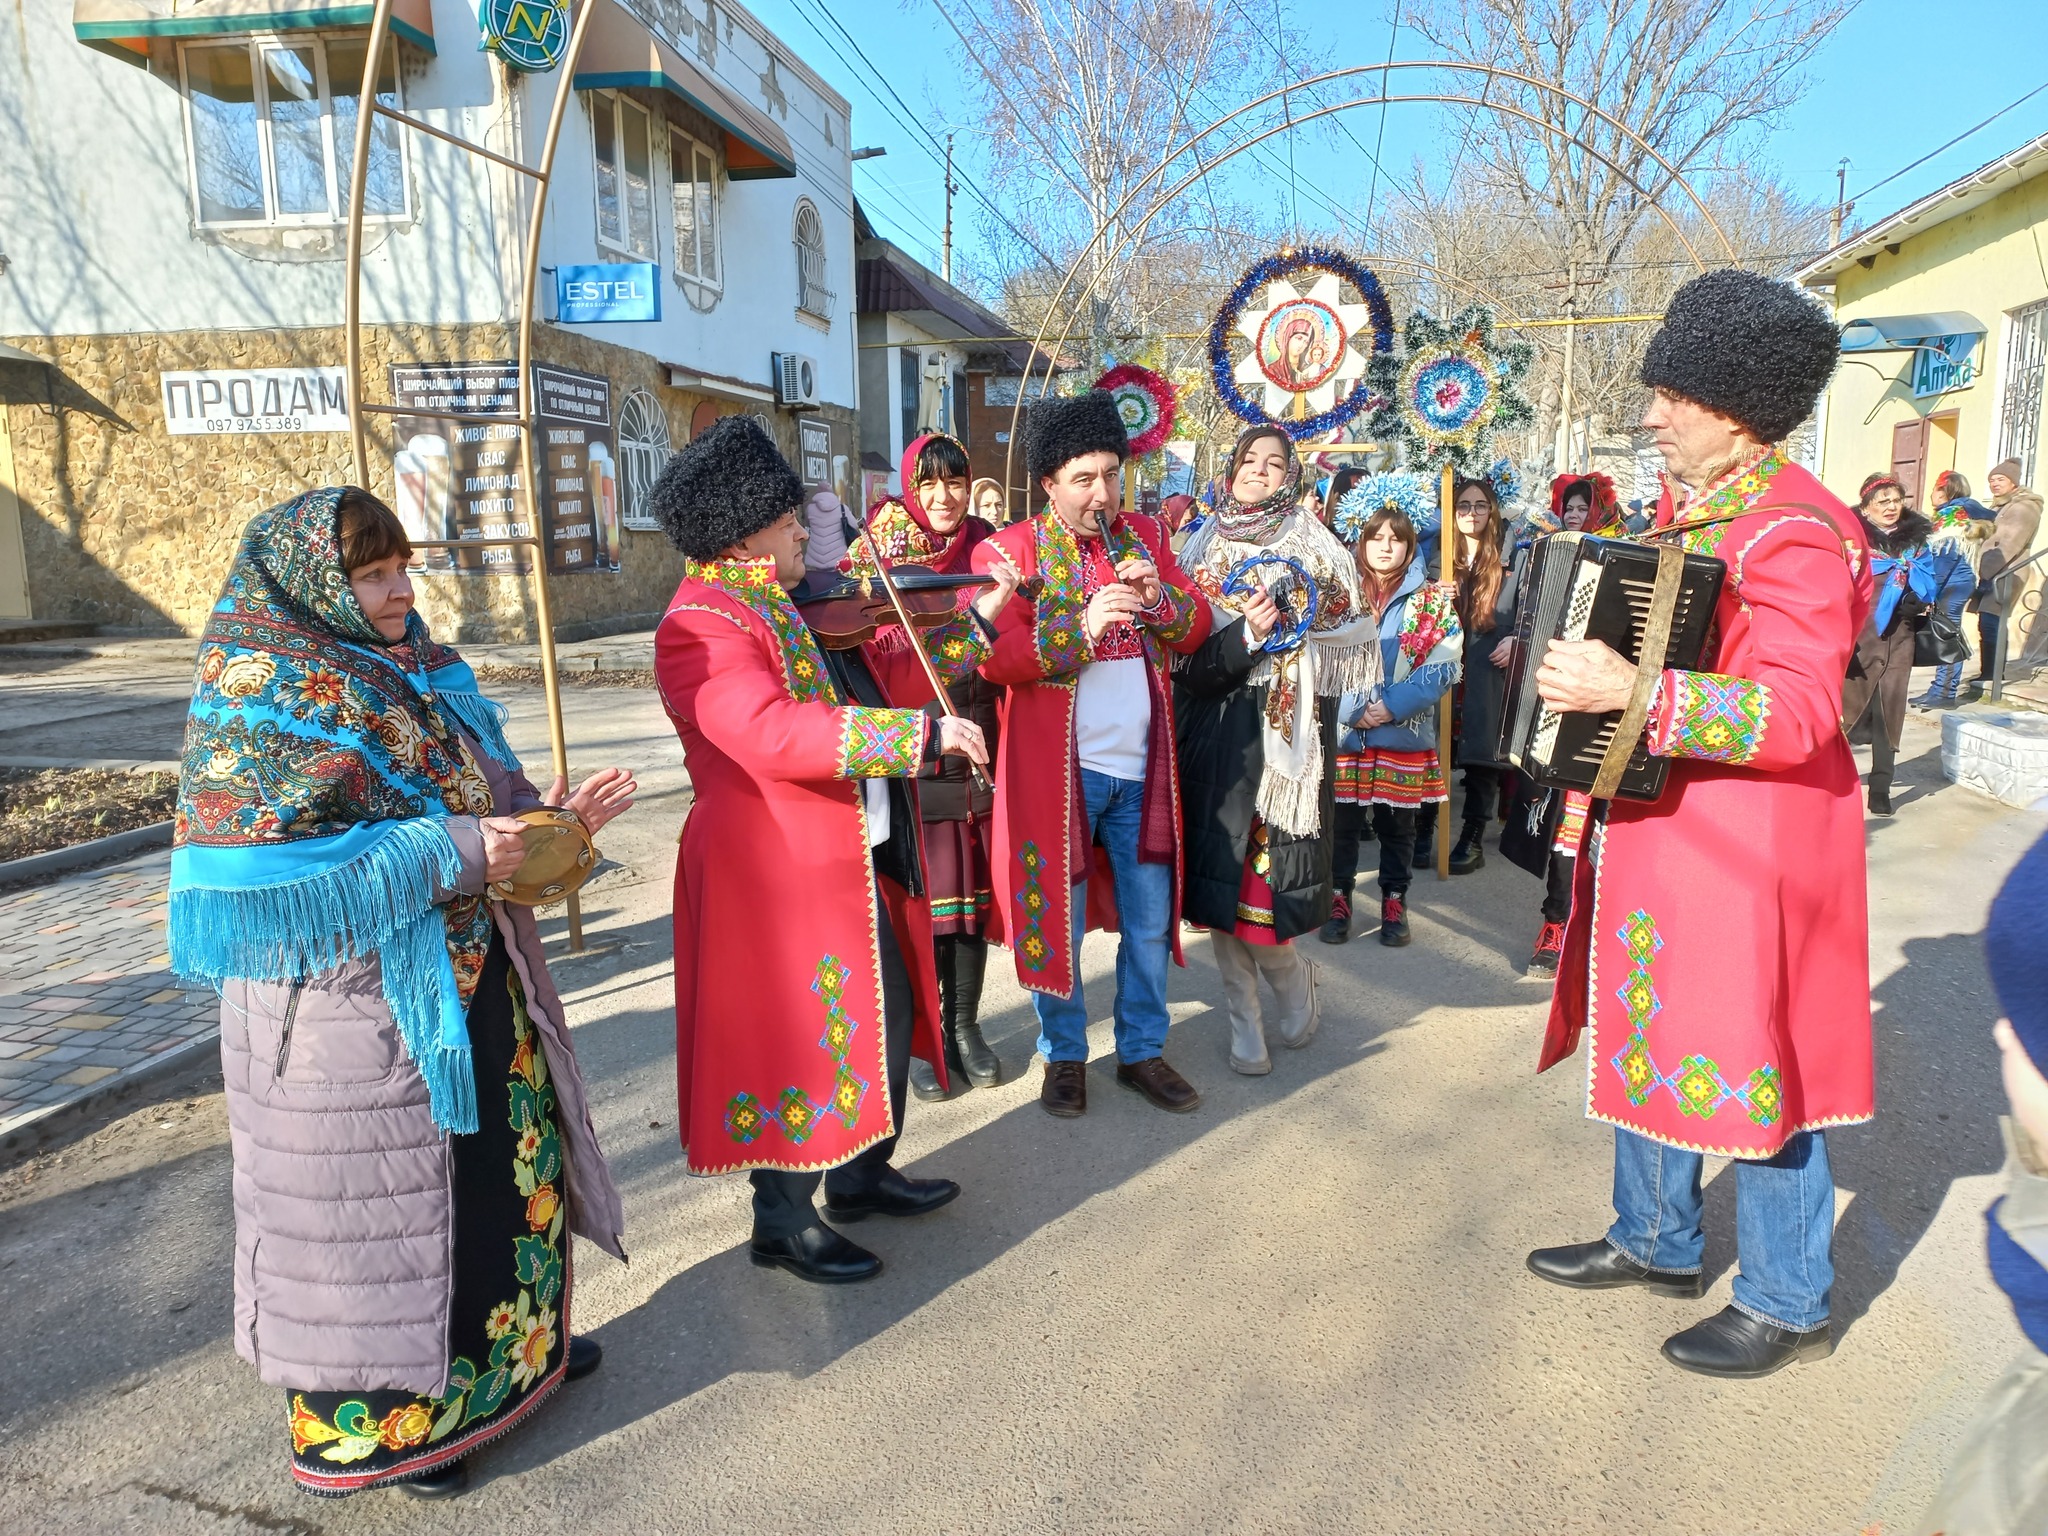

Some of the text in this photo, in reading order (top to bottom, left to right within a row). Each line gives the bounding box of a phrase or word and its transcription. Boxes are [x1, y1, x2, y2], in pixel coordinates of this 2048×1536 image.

[566, 281, 644, 300] ESTEL
[1916, 349, 1971, 394] Аптека
[402, 376, 462, 391] ШИРОЧАЙШИЙ
[465, 377, 496, 390] ВЫБОР
[166, 376, 346, 418] ПРОДАМ
[414, 396, 426, 408] ПО
[428, 394, 477, 408] ОТЛИЧНЫМ
[206, 418, 232, 431] 097
[454, 426, 494, 444] ЖИВОЕ
[548, 430, 585, 444] ЖИВОЕ ПИВО
[477, 450, 506, 468] КВАС
[561, 454, 577, 469] КВАС
[807, 456, 828, 480] МЕСТО
[465, 474, 520, 492] ЛИМОНАД
[555, 477, 584, 493] ЛИМОНАД
[470, 498, 514, 515] МОХИТО
[558, 500, 582, 515] МОХИТО
[565, 523, 591, 540] ЗАКУСОК
[481, 548, 513, 564] РЫБА
[565, 548, 582, 564] РЫБА
